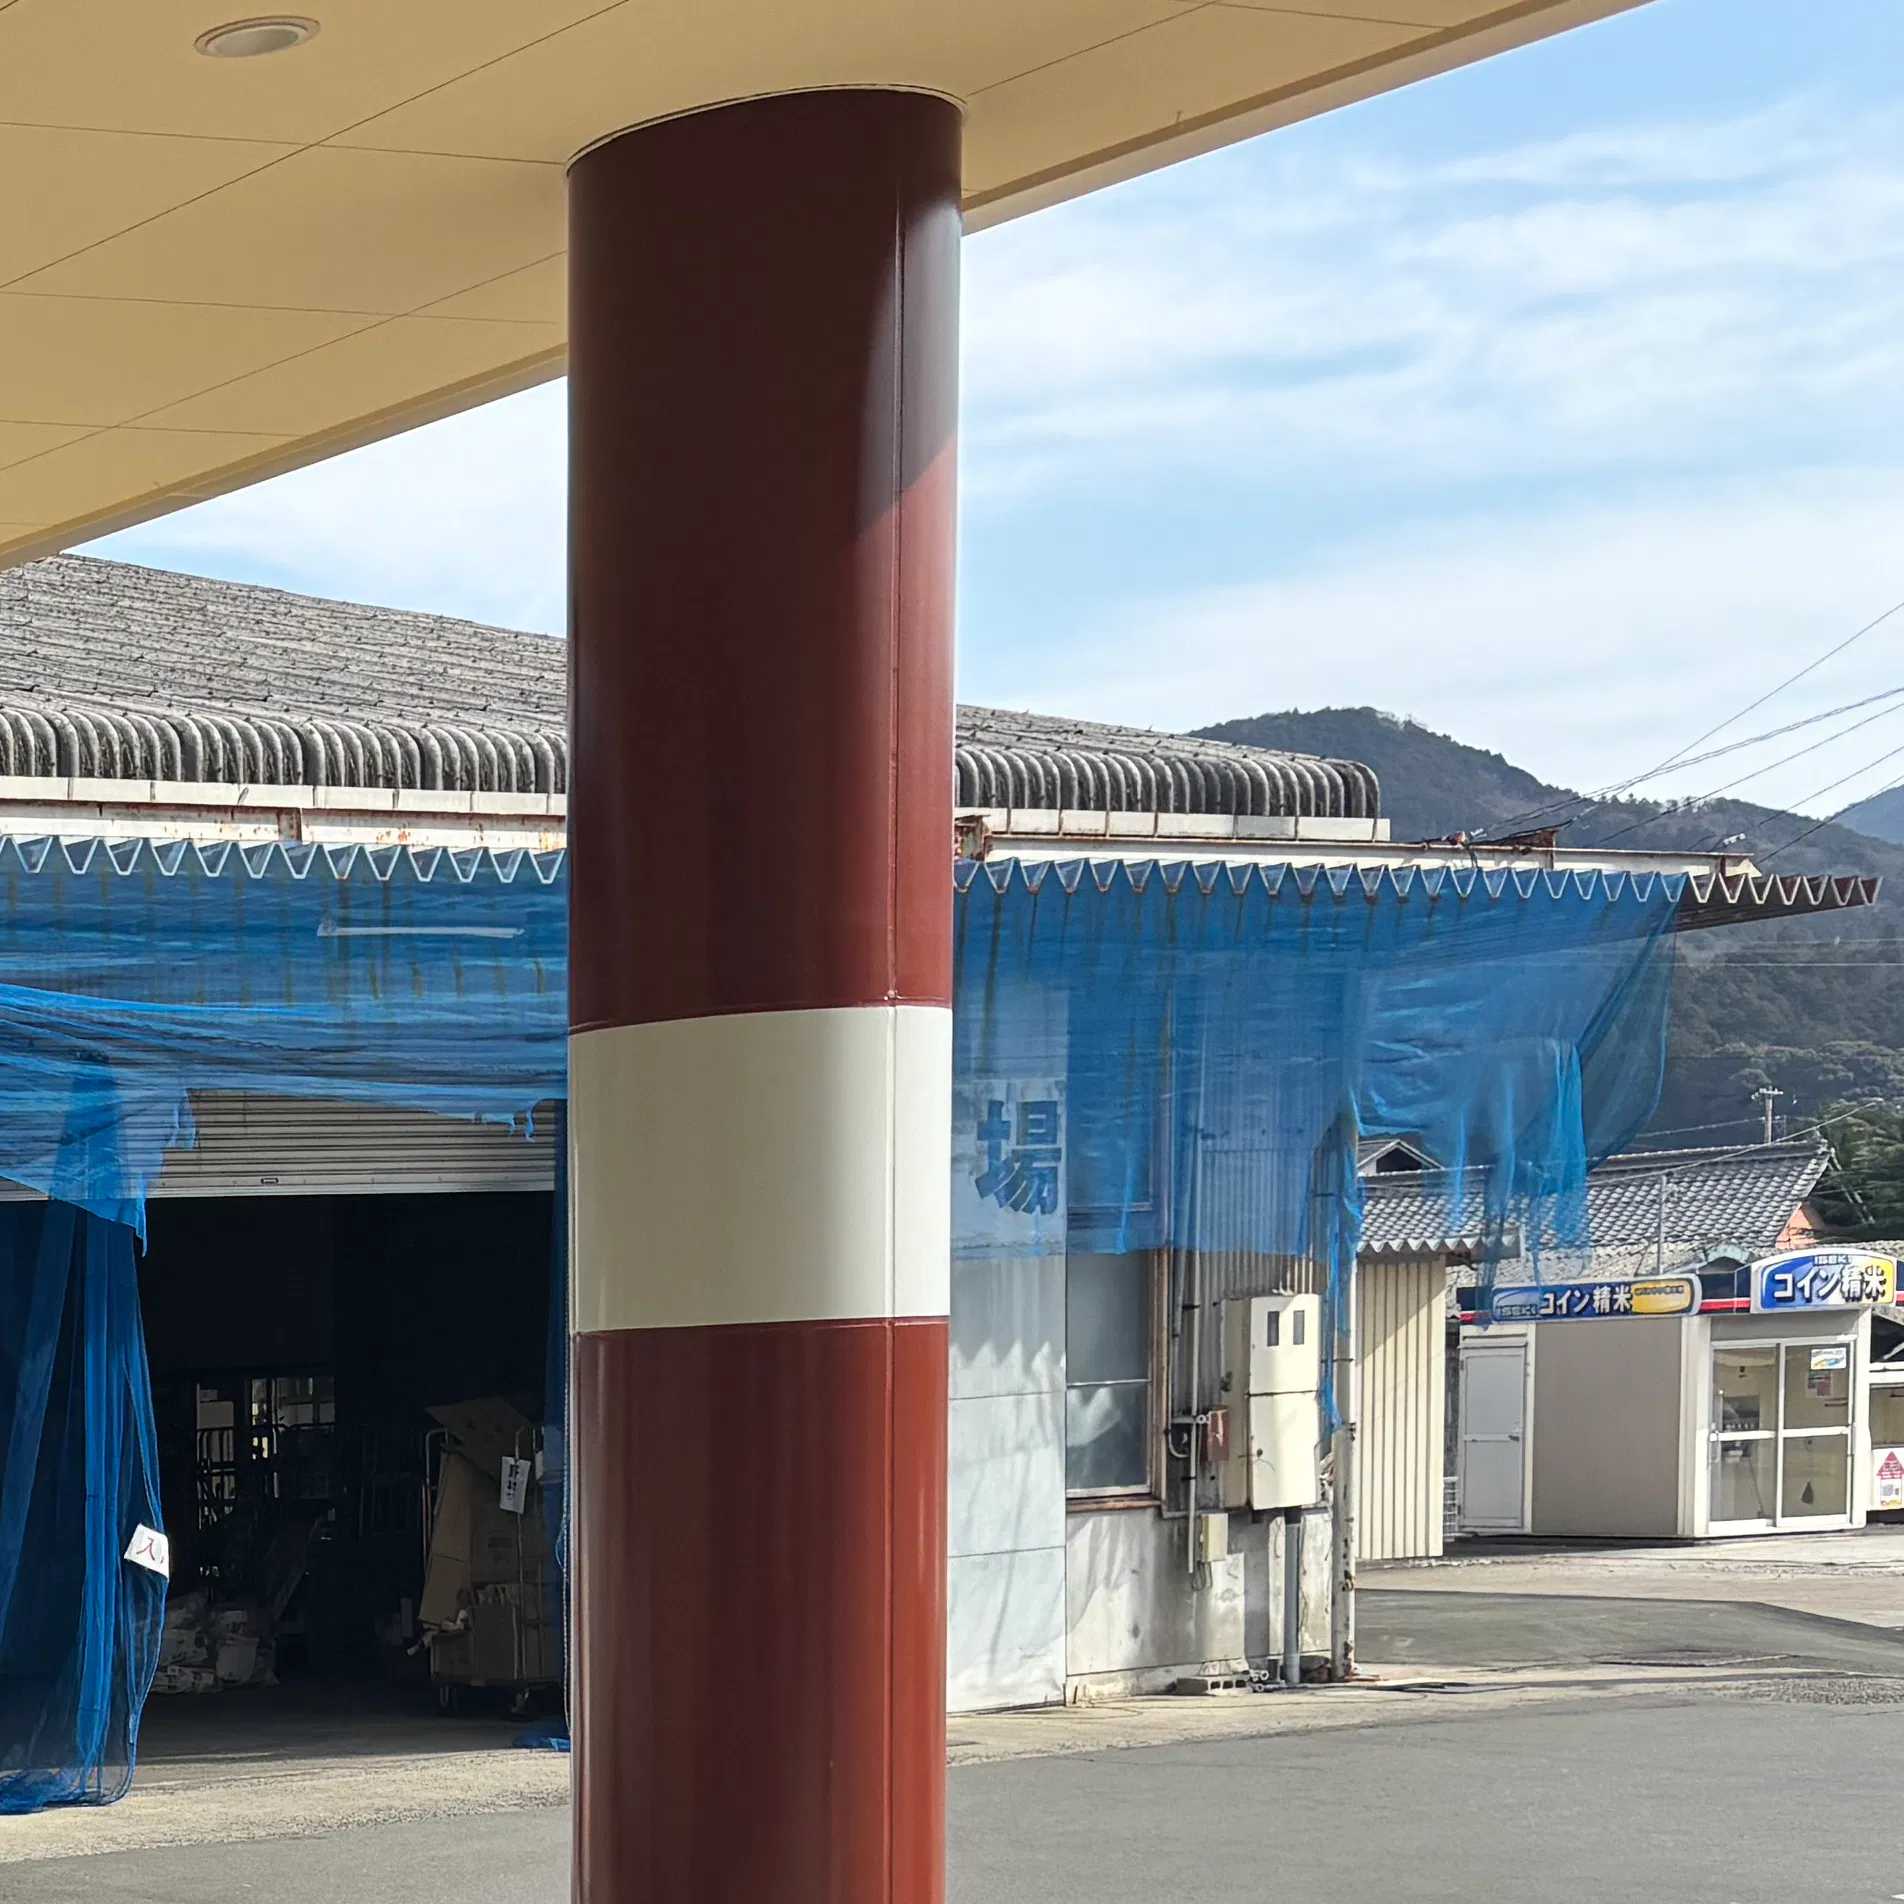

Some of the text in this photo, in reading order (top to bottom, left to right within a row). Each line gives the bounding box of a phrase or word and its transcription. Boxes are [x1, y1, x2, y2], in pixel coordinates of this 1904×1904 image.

[1539, 1284, 1633, 1316] コイン精米
[1773, 1265, 1886, 1302] コイン精米
